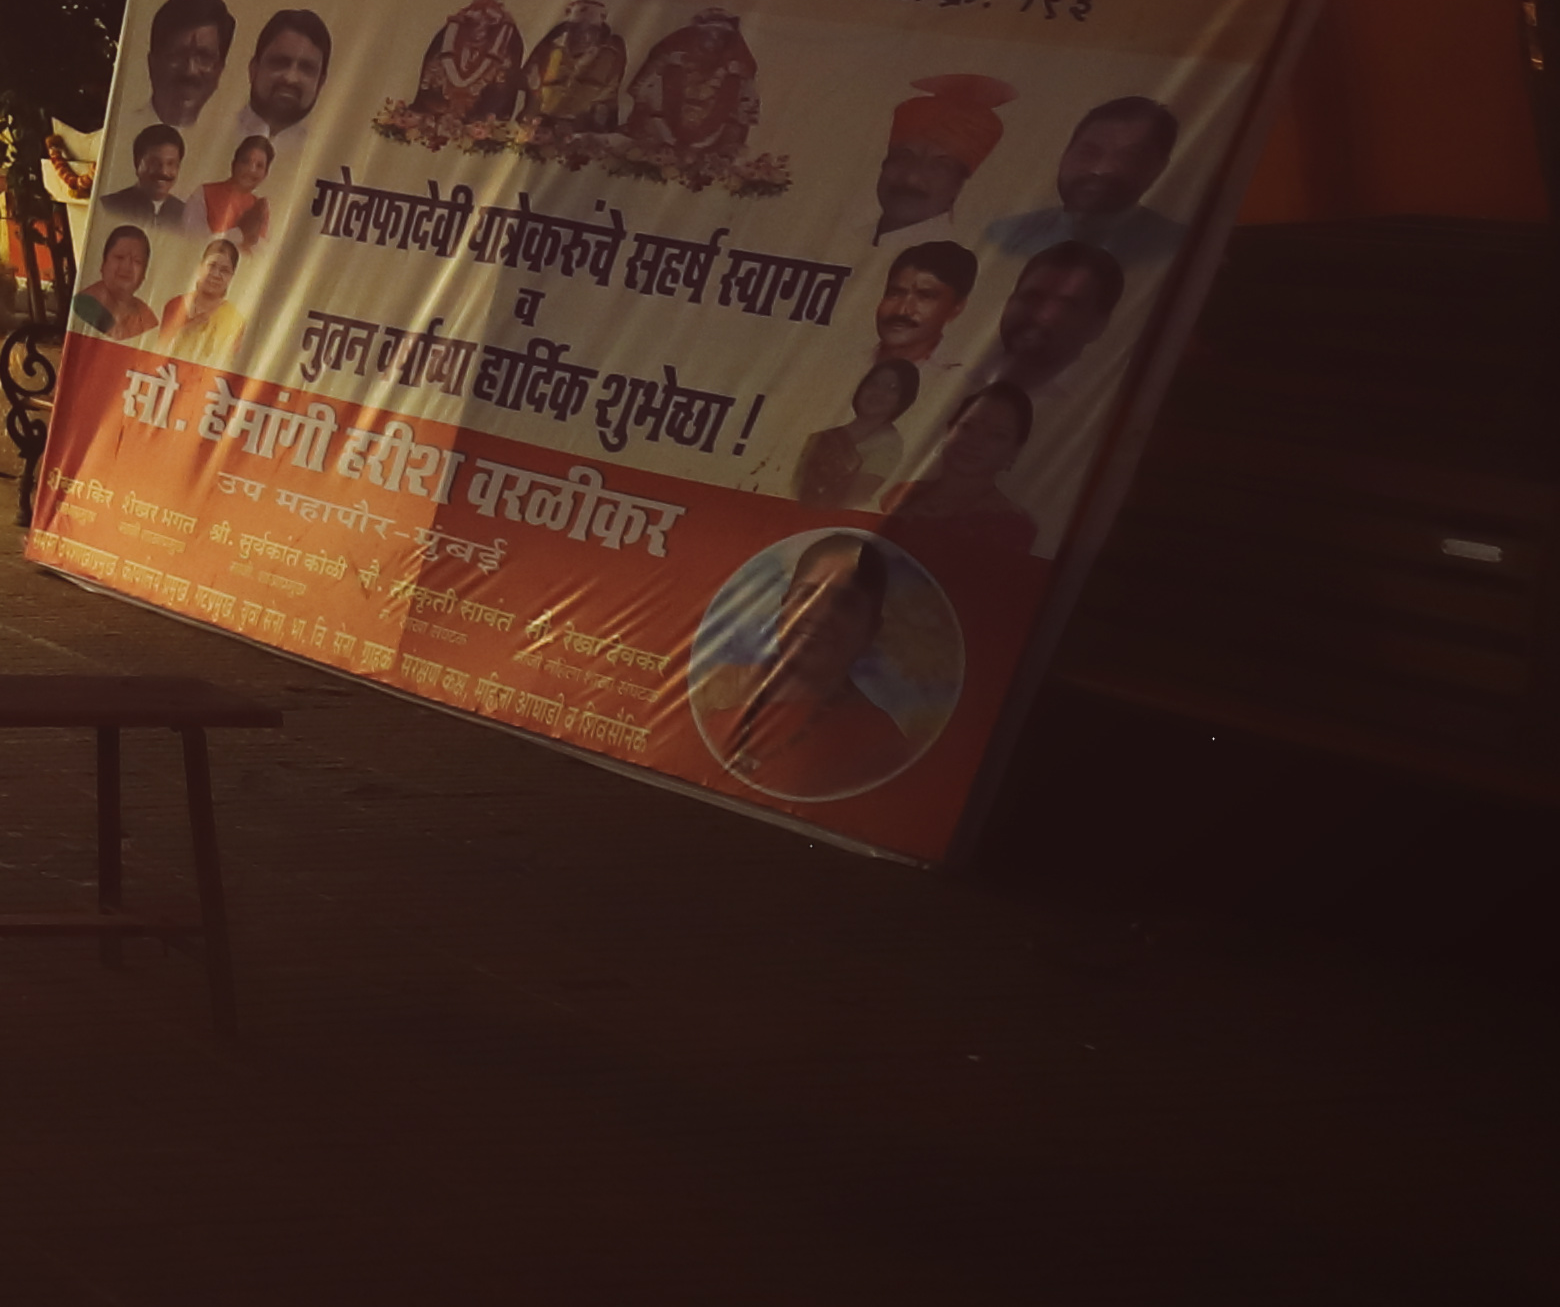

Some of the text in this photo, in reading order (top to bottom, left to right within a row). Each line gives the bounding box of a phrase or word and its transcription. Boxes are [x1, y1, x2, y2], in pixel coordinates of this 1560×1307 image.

[311, 166, 474, 259] गोलफादेवी
[624, 228, 729, 305] सहर्ष
[720, 249, 852, 326] स्वागत
[514, 287, 545, 326] व
[473, 338, 598, 422] हार्दिक
[595, 365, 736, 455] शुभेच्छा
[122, 363, 686, 558] सौ. हेमांगी हरीश वरळीकर
[217, 471, 266, 502] उप
[303, 549, 348, 581] कोळी
